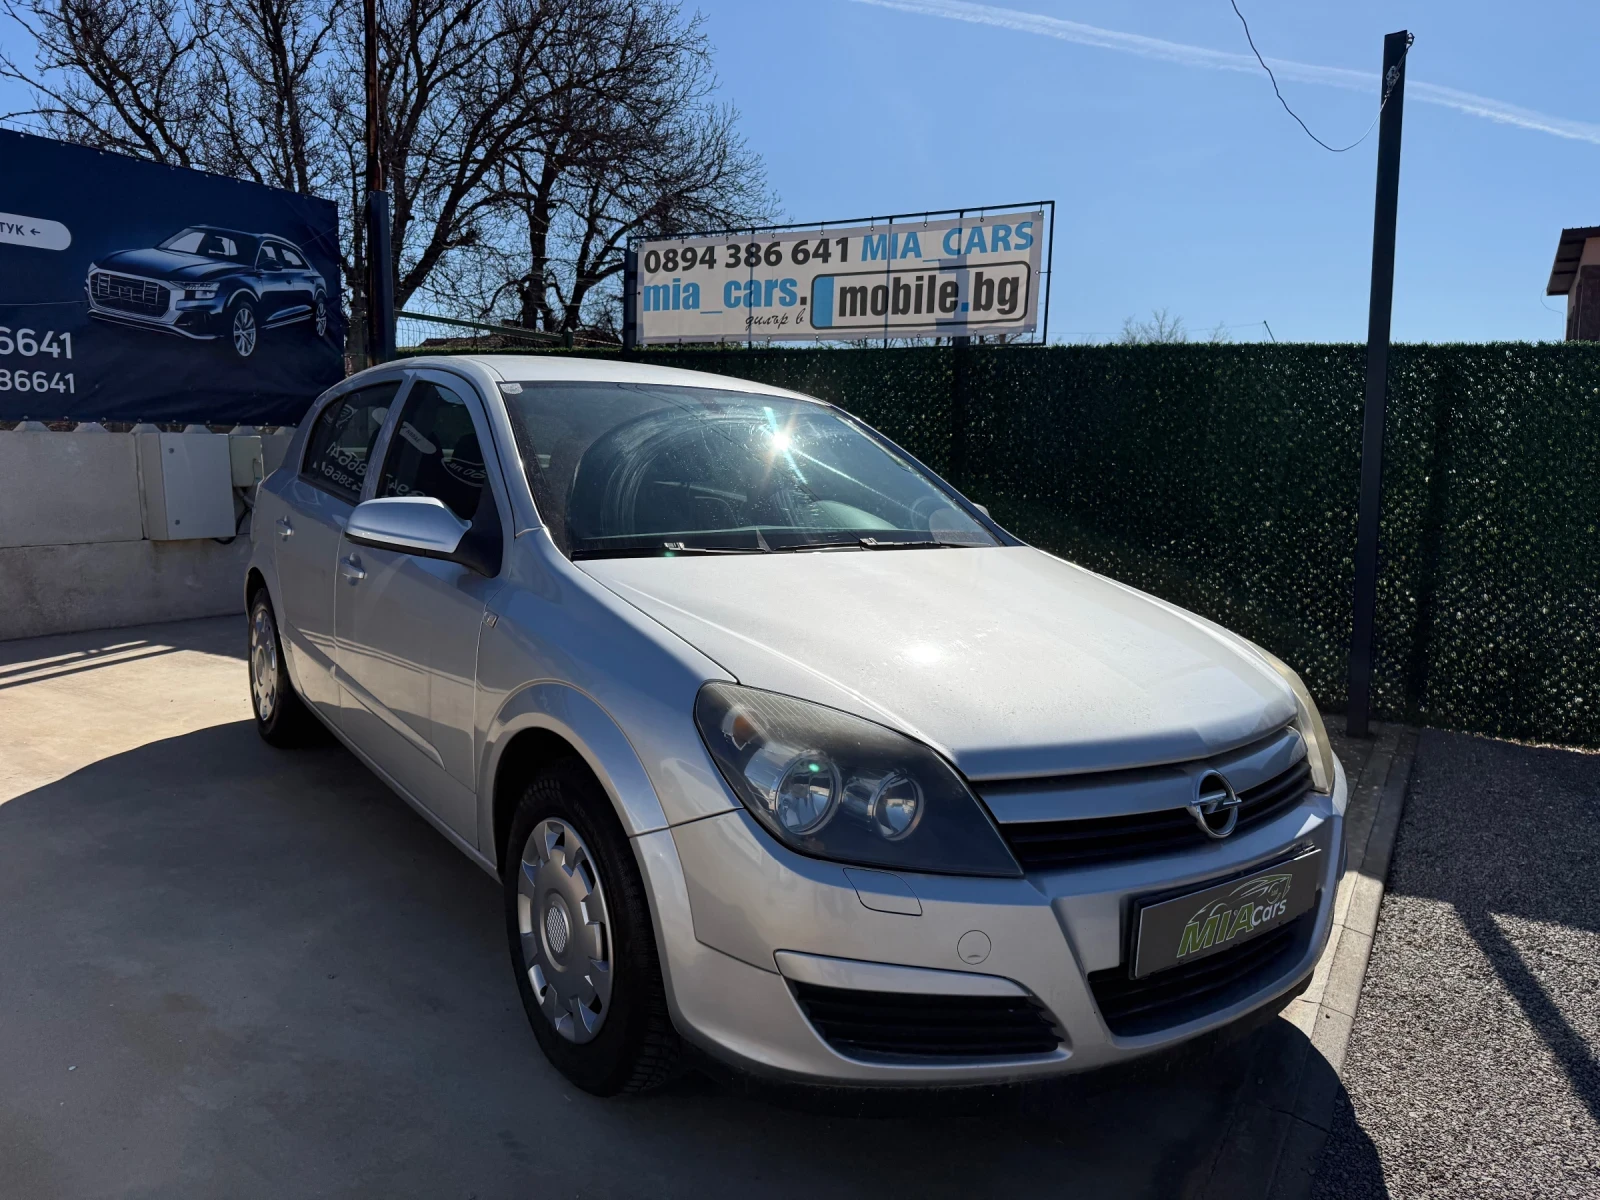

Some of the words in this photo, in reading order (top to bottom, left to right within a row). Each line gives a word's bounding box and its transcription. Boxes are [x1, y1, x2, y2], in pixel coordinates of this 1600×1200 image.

[644, 246, 717, 274] 0894
[725, 241, 783, 269] 386
[791, 236, 849, 265] 641
[838, 271, 1020, 317] mobile.bg
[745, 312, 790, 331] дилър
